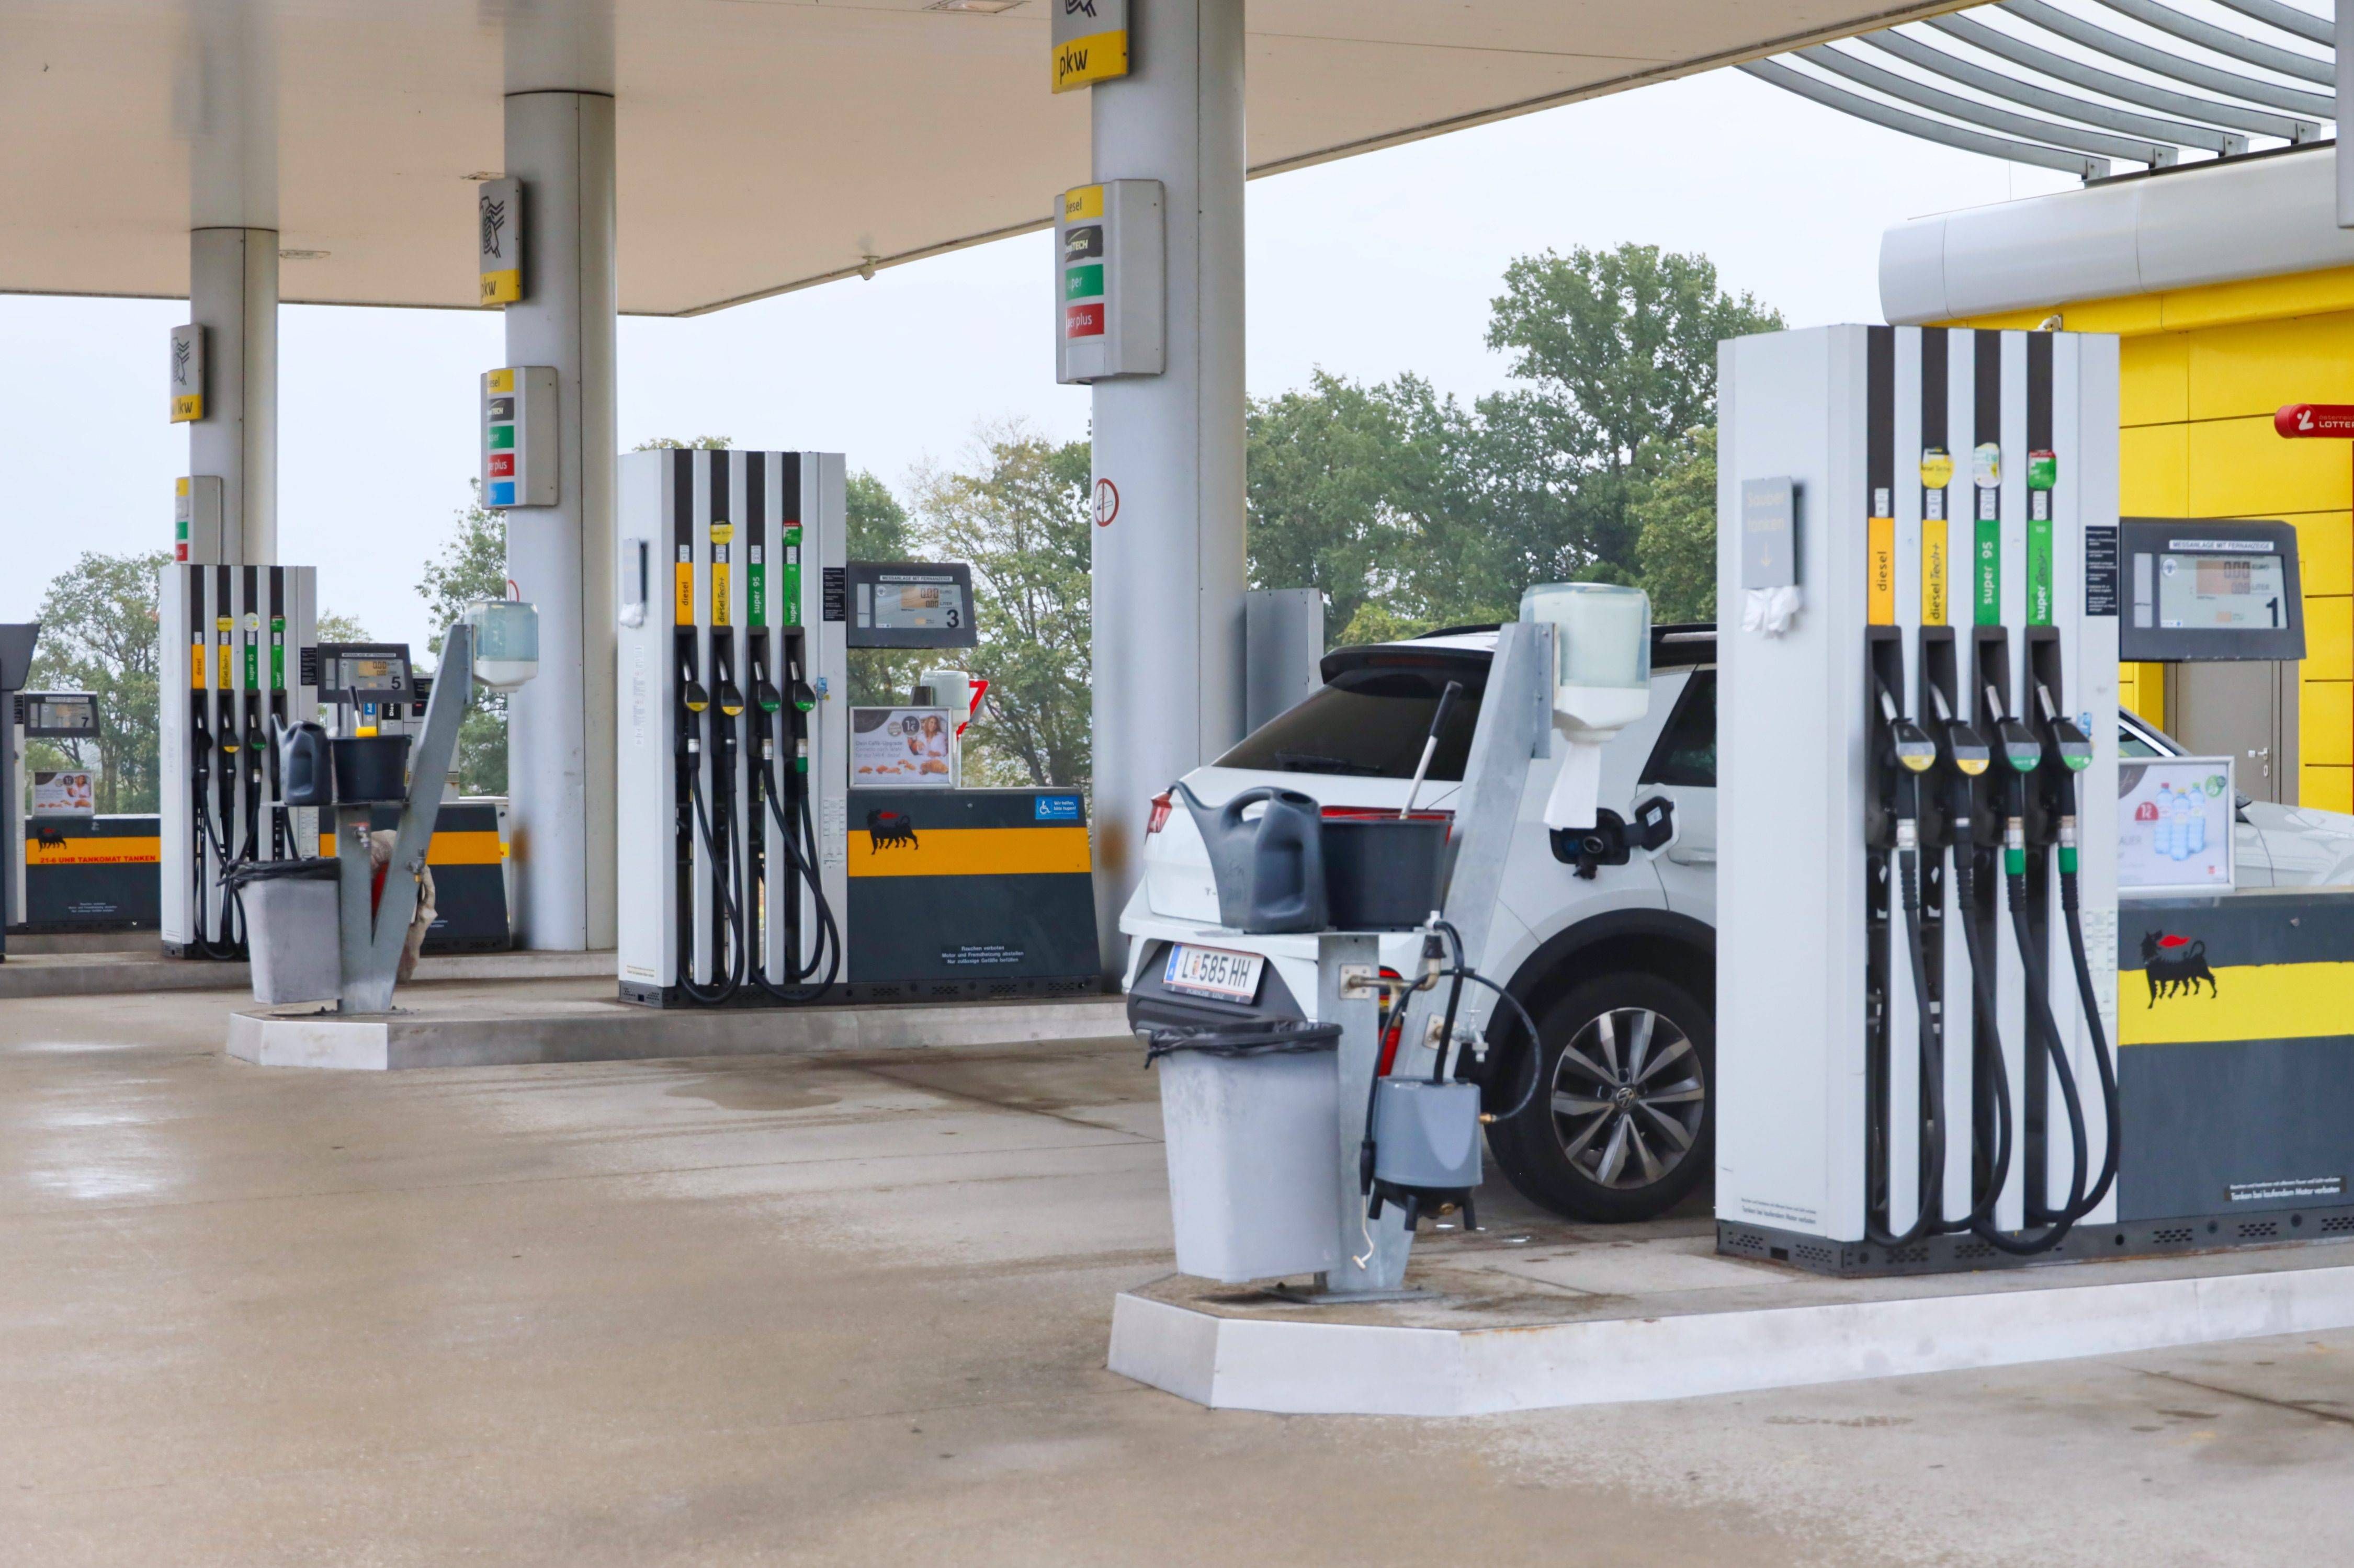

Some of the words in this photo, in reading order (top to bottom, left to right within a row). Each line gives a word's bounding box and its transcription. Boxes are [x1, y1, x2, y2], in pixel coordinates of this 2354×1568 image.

[1060, 46, 1088, 85] pkw
[1982, 541, 1993, 559] 95
[752, 576, 760, 587] 95
[1877, 551, 1887, 592] diesel
[1984, 565, 1995, 605] super
[1931, 583, 1940, 620] diesel
[2037, 585, 2047, 620] super
[2266, 596, 2278, 628] 1
[946, 609, 960, 628] 3
[391, 676, 401, 690] 5
[82, 717, 89, 727] 7
[1182, 950, 1190, 978] L
[1199, 953, 1229, 984] 585
[1228, 958, 1251, 987] HH
[2231, 1191, 2252, 1200] Tanken
[2253, 1190, 2262, 1199] bei
[2263, 1188, 2294, 1198] laufendem
[2295, 1187, 2313, 1196] Motor
[2314, 1185, 2340, 1194] verboten
